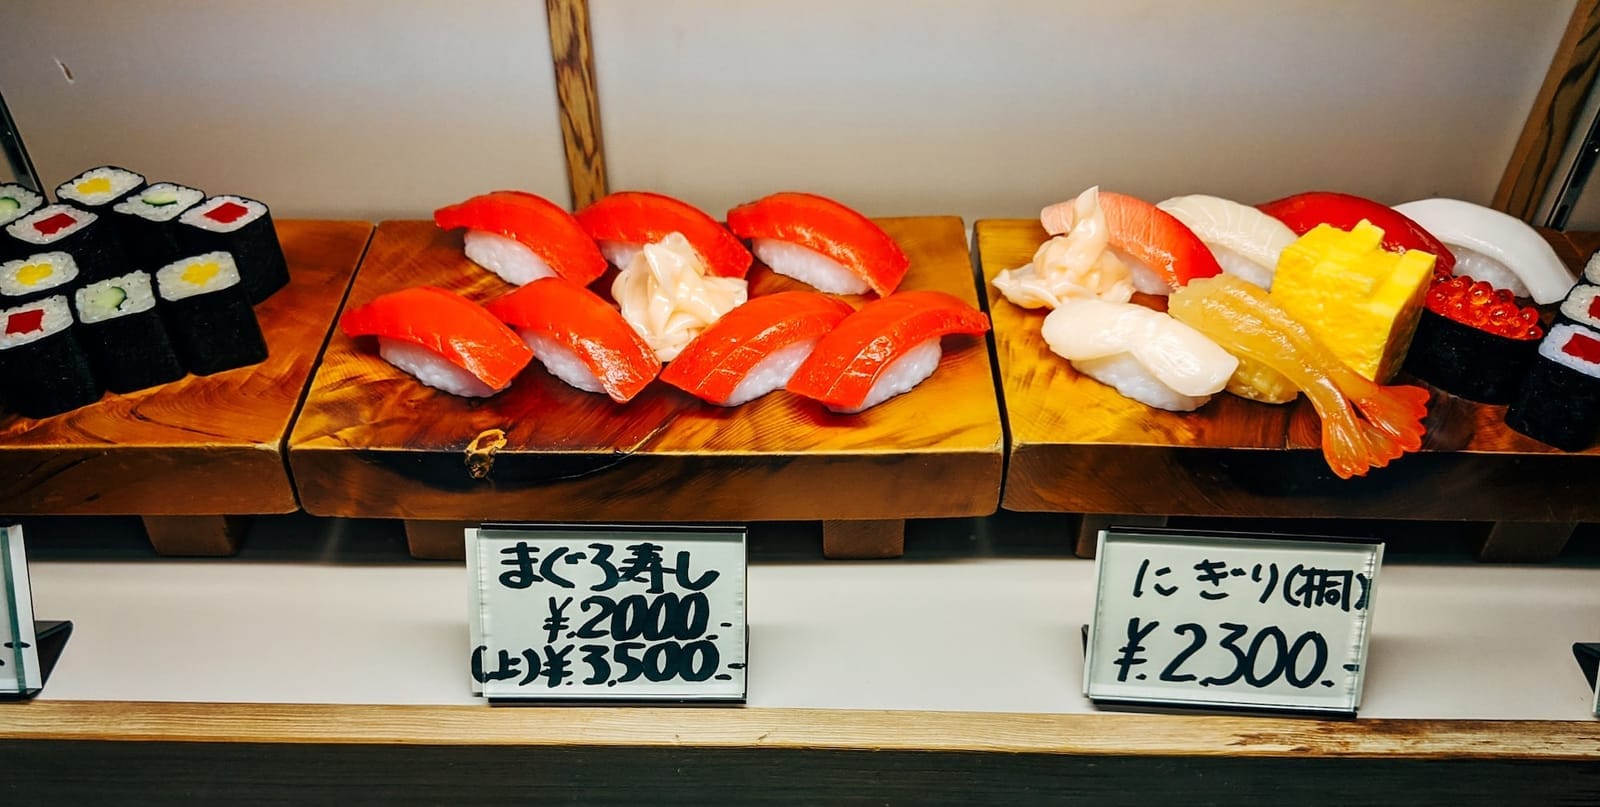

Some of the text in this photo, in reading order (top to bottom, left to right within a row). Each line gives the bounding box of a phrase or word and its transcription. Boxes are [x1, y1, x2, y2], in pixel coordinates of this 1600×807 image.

[499, 541, 721, 593] まぐろ寿し
